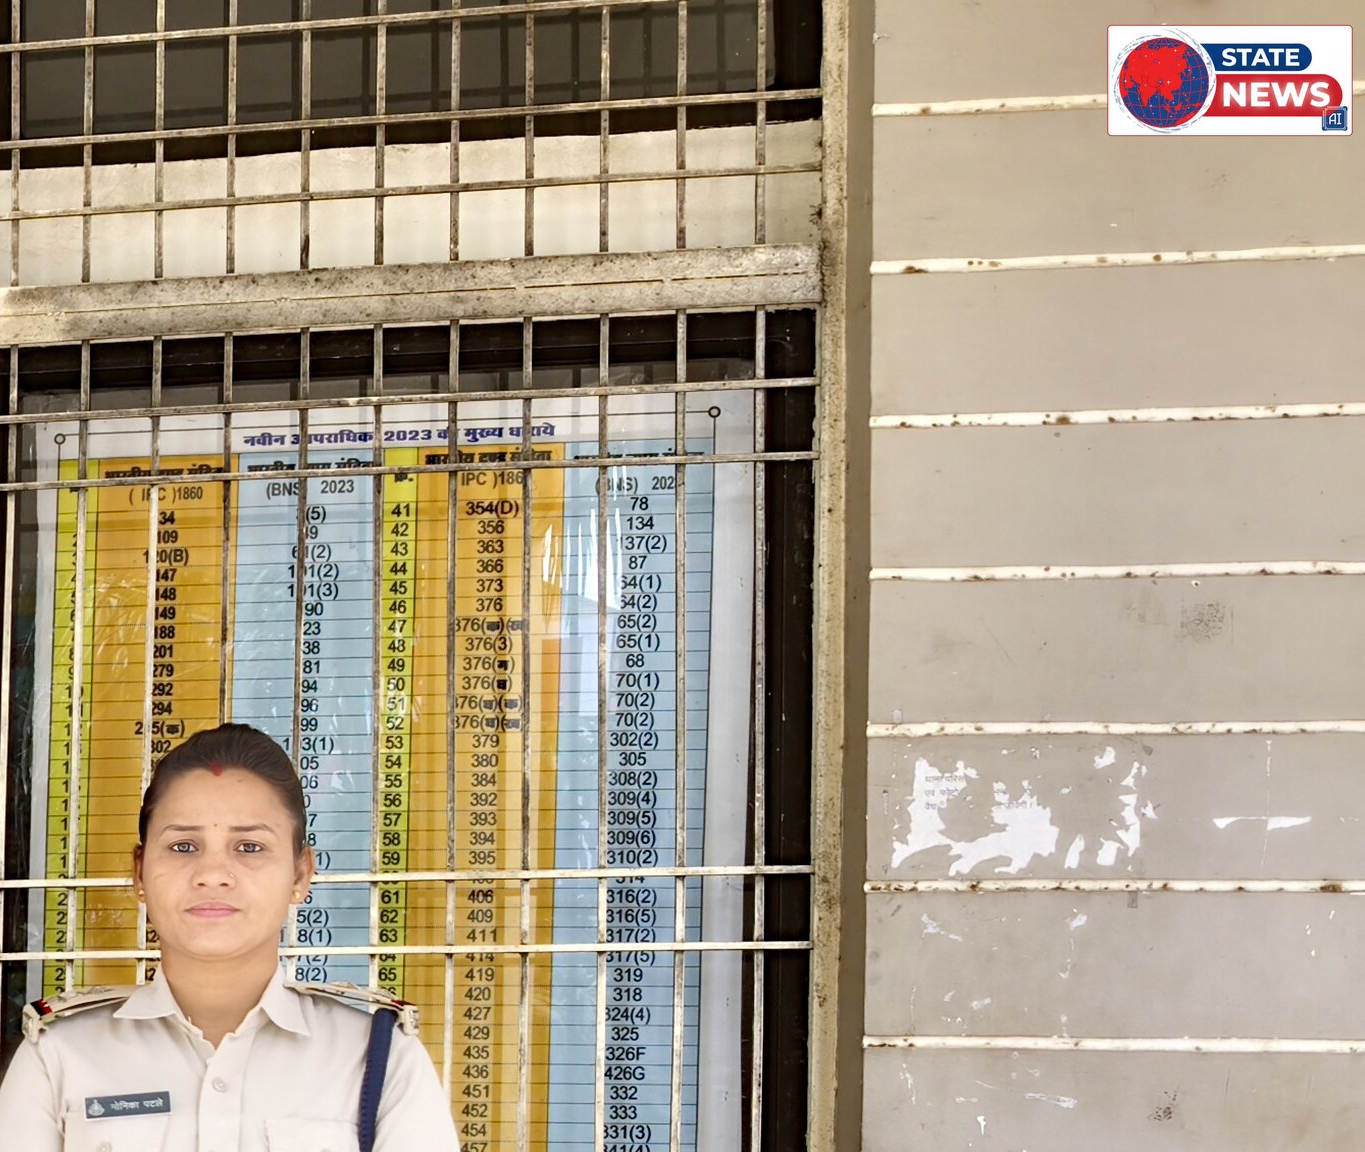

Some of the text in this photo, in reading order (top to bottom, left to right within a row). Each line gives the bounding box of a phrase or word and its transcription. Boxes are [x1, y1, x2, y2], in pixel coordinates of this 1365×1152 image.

[384, 430, 432, 442] 2023
[460, 469, 525, 489] IPC )186
[651, 475, 674, 490] 202
[266, 480, 355, 500] (BNS 2023
[391, 496, 649, 519] 41 354(D) 78
[158, 511, 175, 525] 34
[391, 516, 655, 537] 42 356 134
[390, 542, 408, 556] 43
[477, 539, 504, 554] 363
[143, 550, 189, 566] 10(B)
[389, 556, 647, 576] 44 366 87
[288, 563, 339, 580] 11(2)
[287, 583, 339, 600] 11(3)
[389, 581, 407, 595] 45
[476, 578, 503, 592] 373
[389, 600, 407, 613] 46
[475, 598, 503, 612] 376
[388, 619, 406, 633] 47
[618, 614, 657, 631] 65(2)
[153, 645, 174, 658] 201
[387, 634, 660, 653] 48 376(3) 65(1)
[152, 664, 174, 678] 279
[387, 658, 405, 671] 49
[626, 654, 645, 668] 68
[151, 683, 173, 696] 292
[386, 677, 405, 691] 50
[616, 673, 660, 691] 70(1)
[151, 702, 172, 716] 294
[386, 696, 405, 711] 51
[615, 693, 655, 710] 70(2)
[386, 716, 404, 730] 52
[615, 712, 655, 729] 70(2)
[282, 736, 335, 753] 13(1)
[385, 732, 658, 750] 53 379 302(2)
[384, 752, 647, 769] 54 380 305
[384, 771, 658, 788] 55 384 308(2)
[383, 791, 657, 808] 56 392 309(4)
[382, 810, 657, 828] 57 393 309(5)
[382, 830, 656, 847] 58 394 309(6)
[381, 850, 659, 866] 59 395 310(2)
[381, 889, 657, 906] 61 406 316(2)
[380, 909, 656, 926] 62 409 316(5)
[379, 928, 656, 943] 63 411 317(2)
[378, 968, 643, 982] 65 419 319
[464, 987, 643, 1002] 420 318
[463, 1006, 491, 1021] 427
[463, 1026, 639, 1041] 429 325
[463, 1045, 646, 1060] 435 326F
[462, 1065, 645, 1080] 436 426G
[462, 1085, 638, 1100] 451 332
[461, 1104, 638, 1120] 452 333
[461, 1123, 487, 1137] 454
